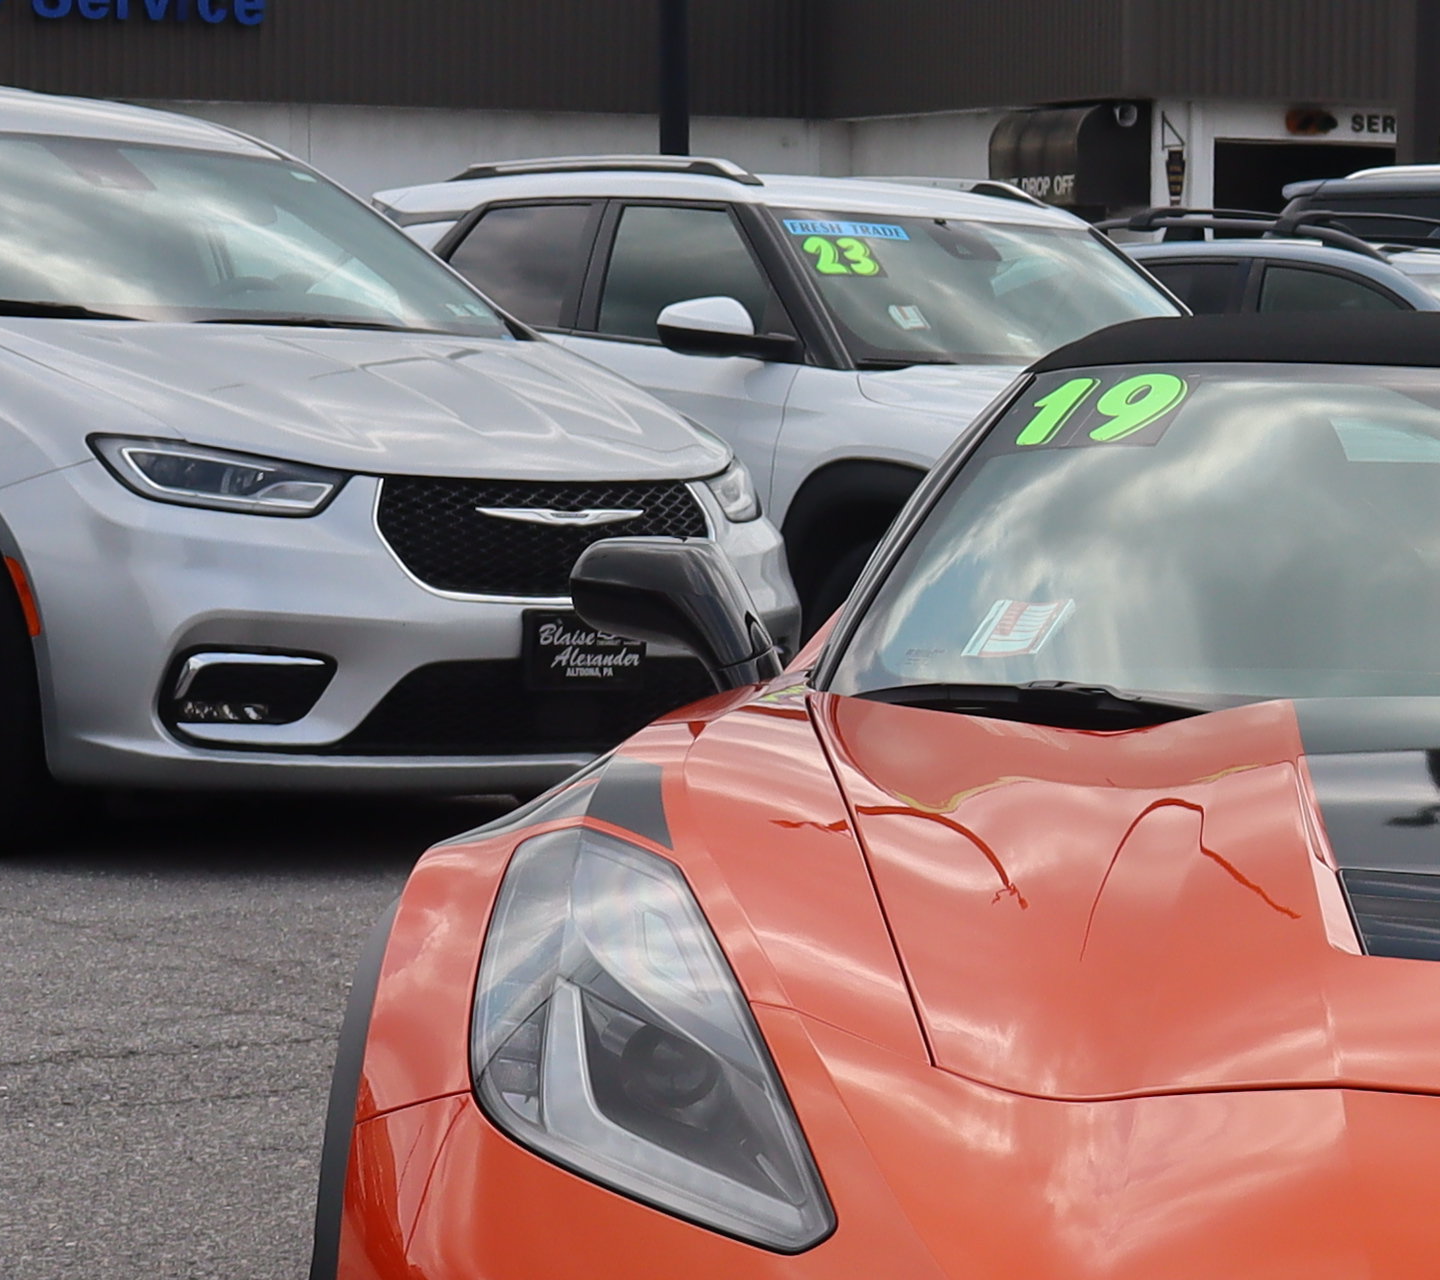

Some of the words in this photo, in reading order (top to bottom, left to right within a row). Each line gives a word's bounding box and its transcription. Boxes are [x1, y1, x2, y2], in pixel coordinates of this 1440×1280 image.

[1021, 176, 1051, 197] DROP
[1053, 174, 1076, 196] OFF
[789, 222, 844, 234] FRESH
[850, 225, 905, 238] TRADE
[803, 236, 880, 276] 23
[1015, 373, 1189, 446] 19
[538, 622, 597, 646] Blaise
[550, 646, 641, 668] Alexander
[603, 667, 614, 677] PA
